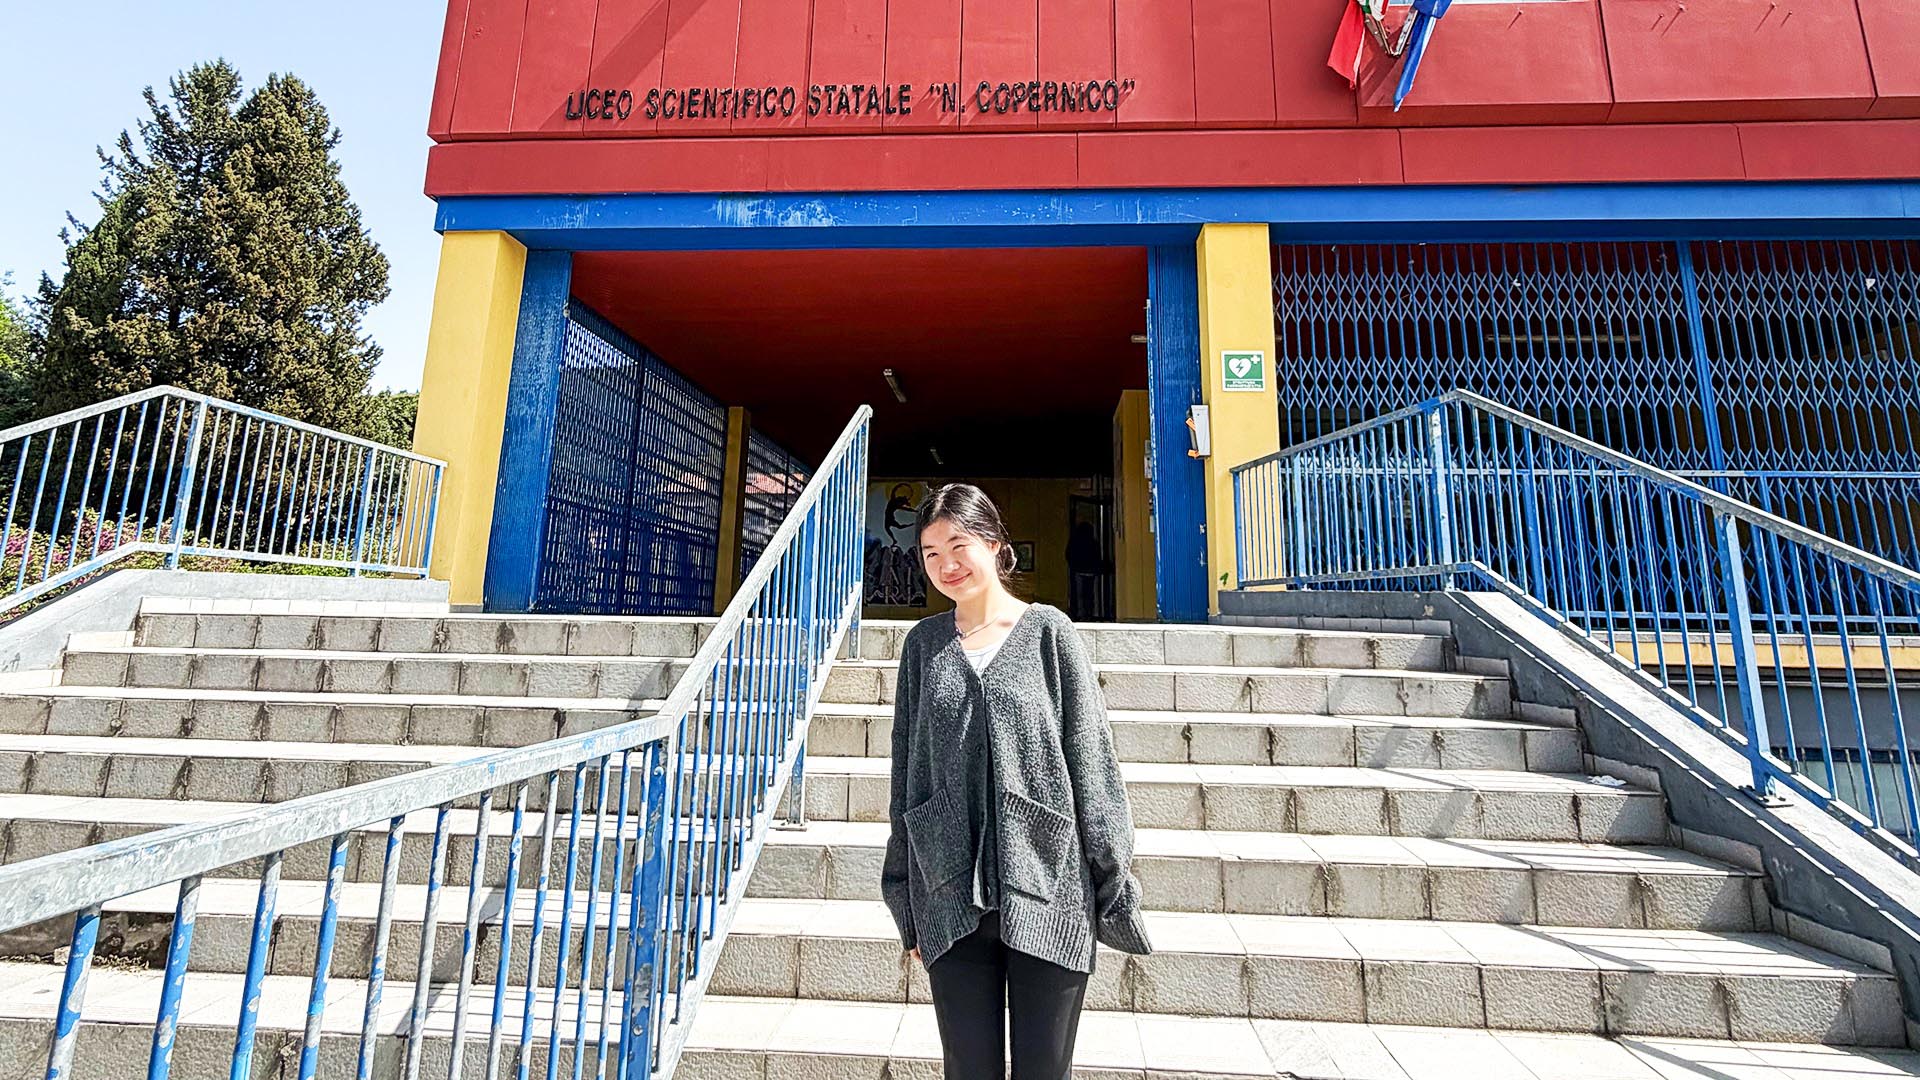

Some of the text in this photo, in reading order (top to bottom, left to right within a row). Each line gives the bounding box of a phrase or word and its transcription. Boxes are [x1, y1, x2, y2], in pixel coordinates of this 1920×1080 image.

[565, 89, 633, 120] LICEO
[646, 86, 796, 119] SCIENTIFICO
[808, 84, 912, 115] STATALE
